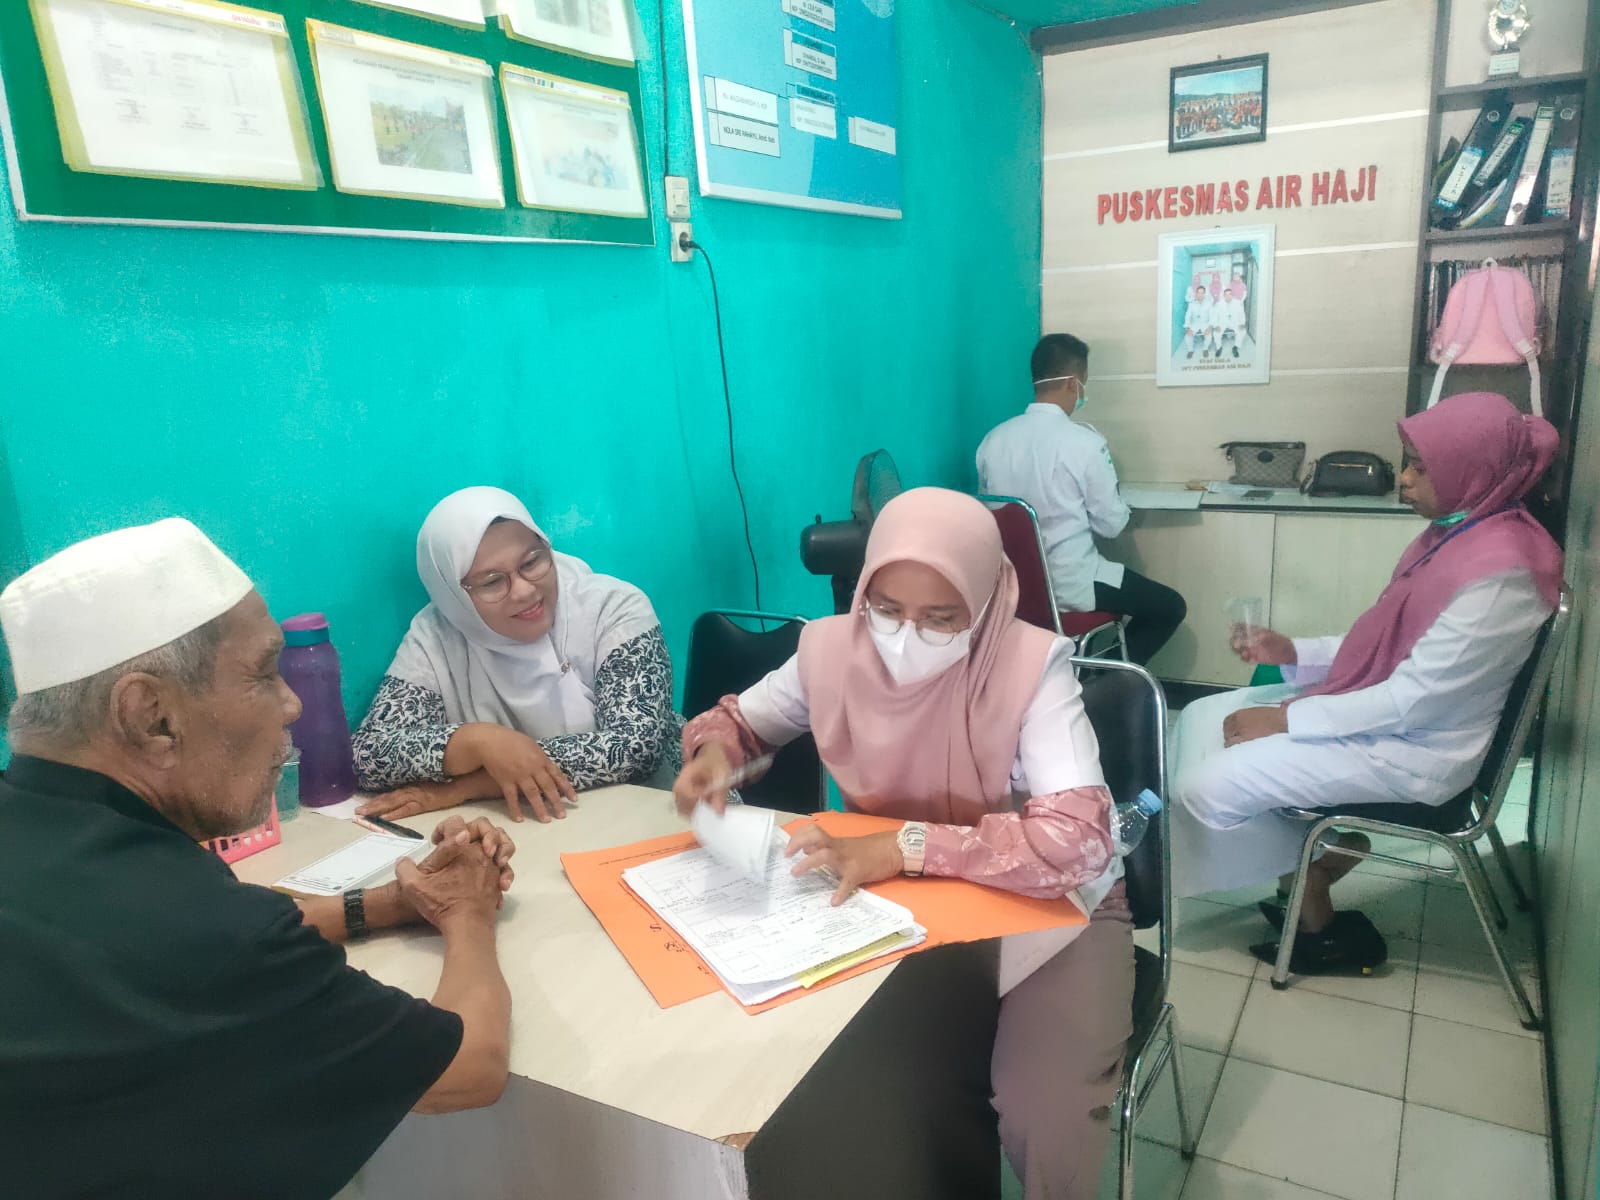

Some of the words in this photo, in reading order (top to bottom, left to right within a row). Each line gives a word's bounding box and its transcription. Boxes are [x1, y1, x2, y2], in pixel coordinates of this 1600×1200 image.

[1097, 180, 1250, 226] PUSKESMAS
[1255, 175, 1303, 211] AIR
[1311, 165, 1378, 206] HAJI
